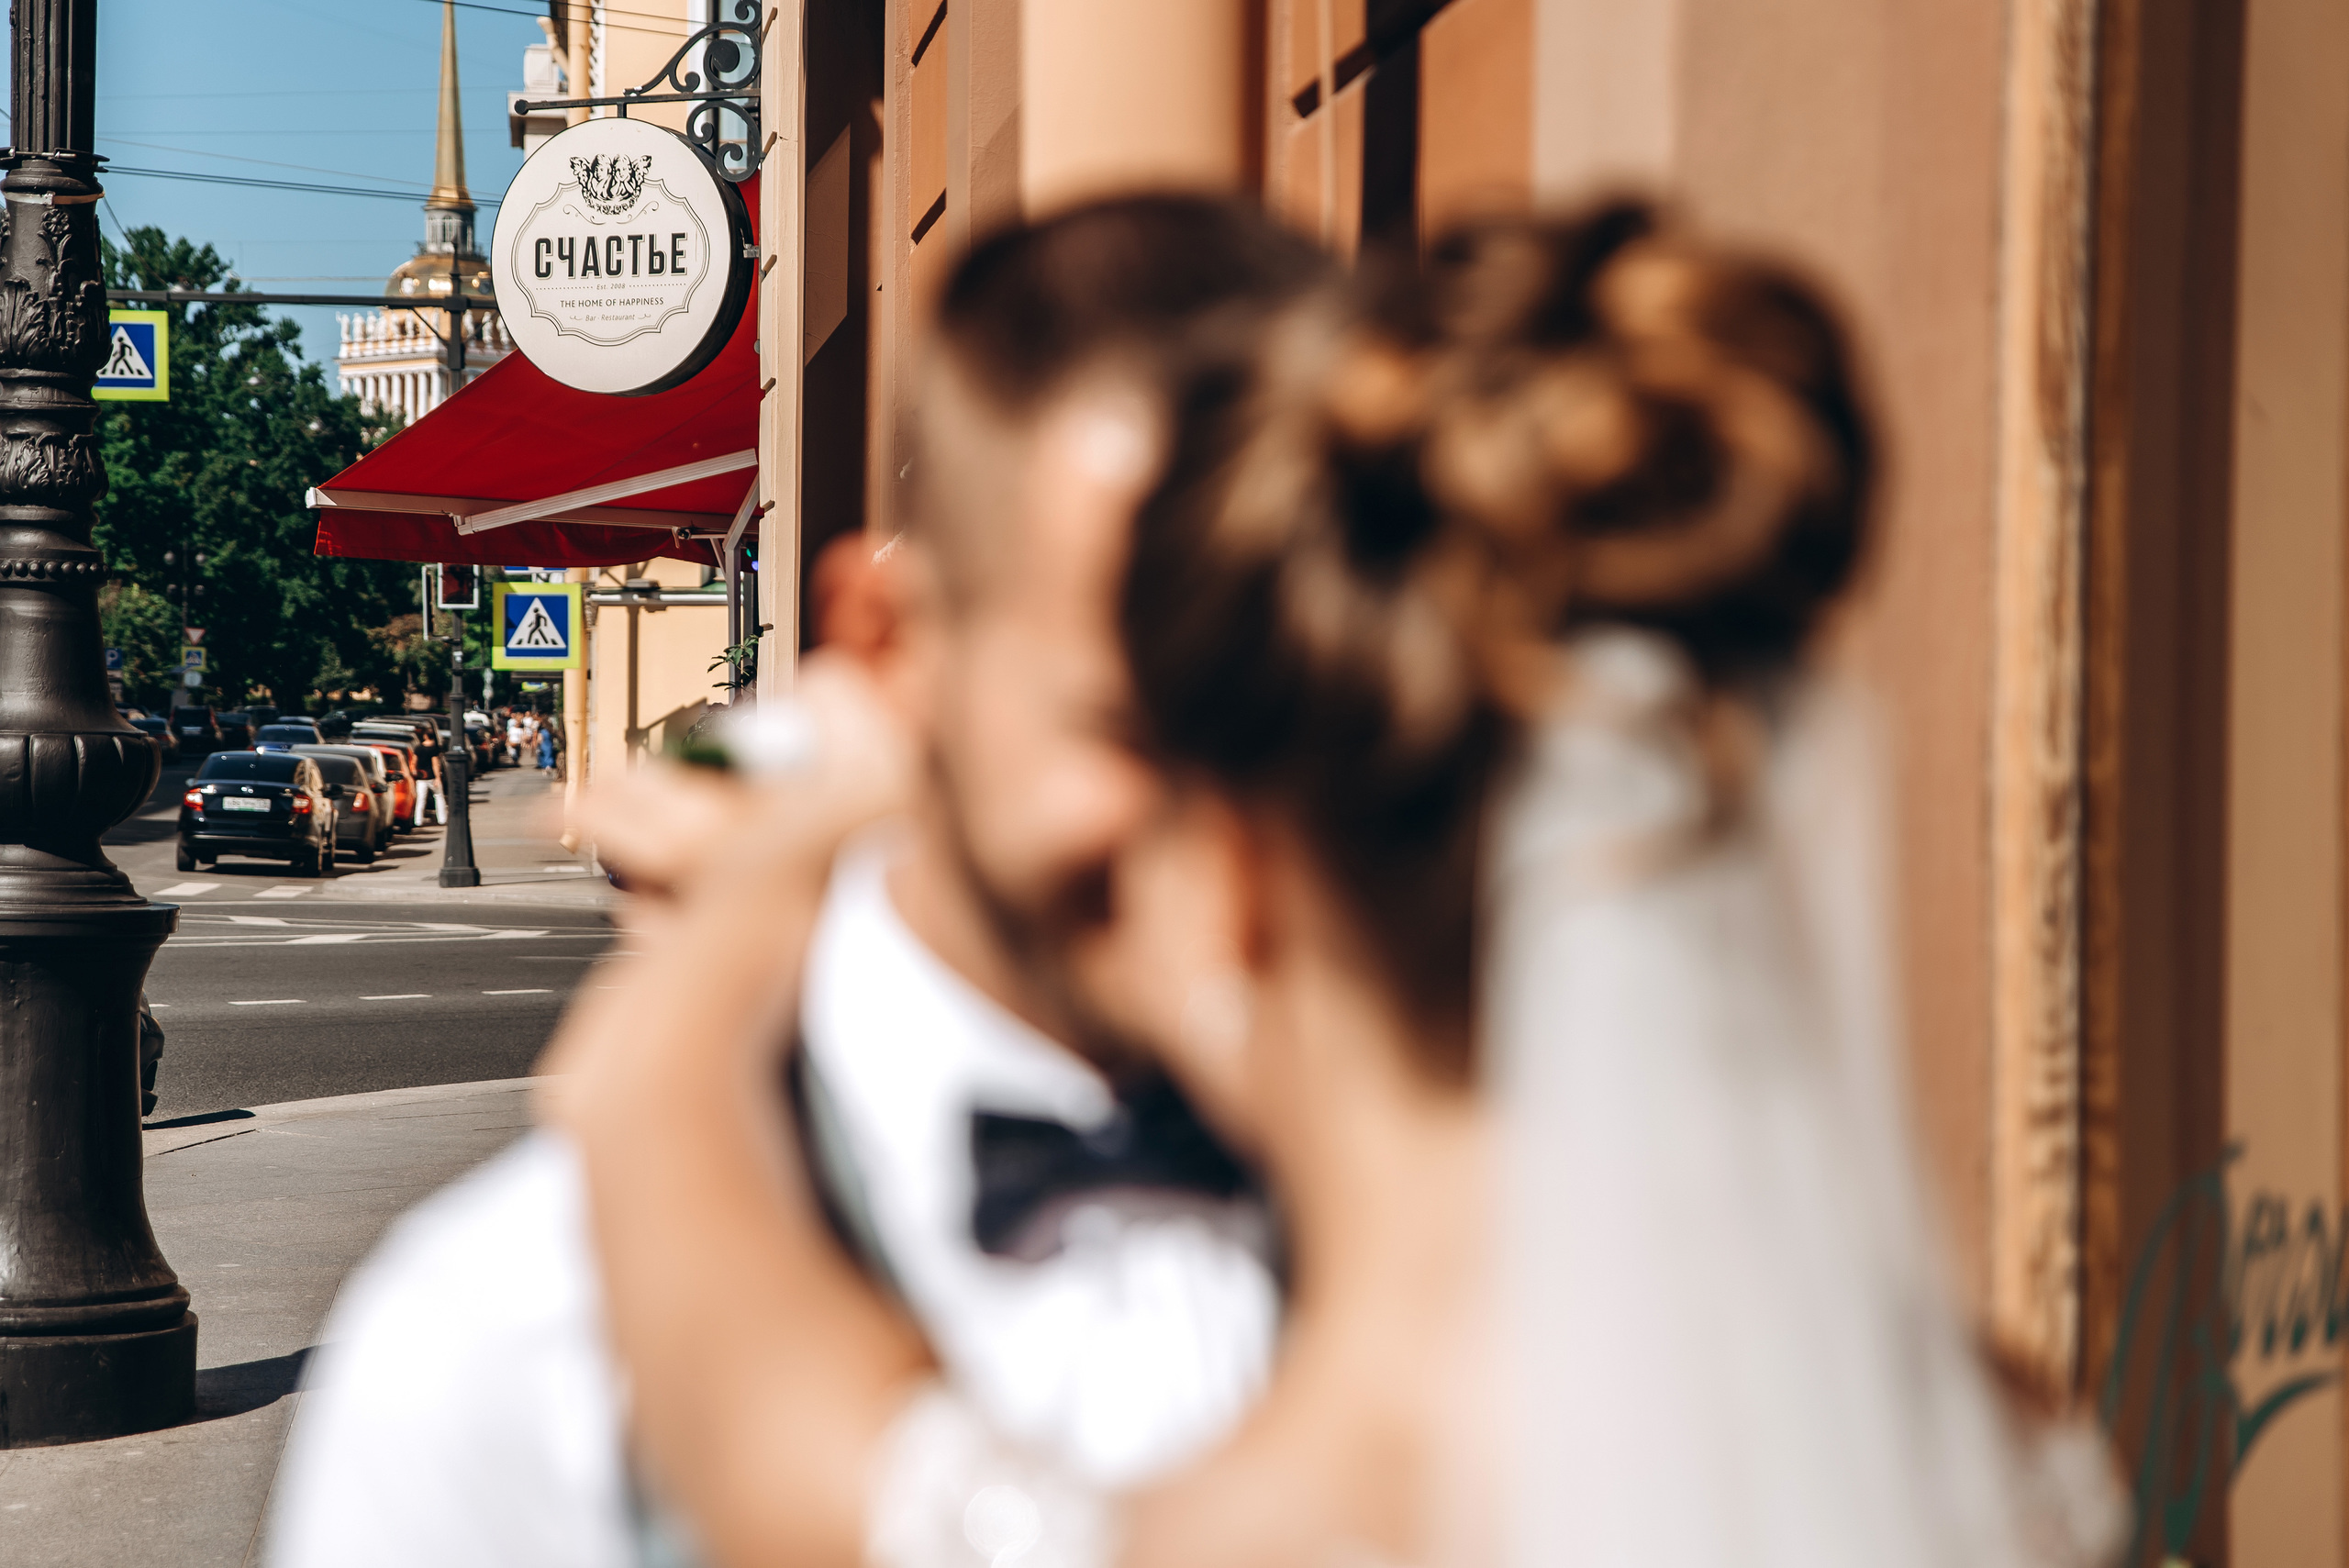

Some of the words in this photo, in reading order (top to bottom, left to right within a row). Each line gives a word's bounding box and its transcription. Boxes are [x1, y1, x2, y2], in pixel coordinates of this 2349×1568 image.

[535, 232, 687, 280] СЧАСТЬЕ
[560, 299, 575, 307] THE
[578, 298, 603, 307] HOME
[606, 298, 617, 306] OF
[618, 296, 664, 306] HAPPINESS
[585, 314, 596, 322] Bar
